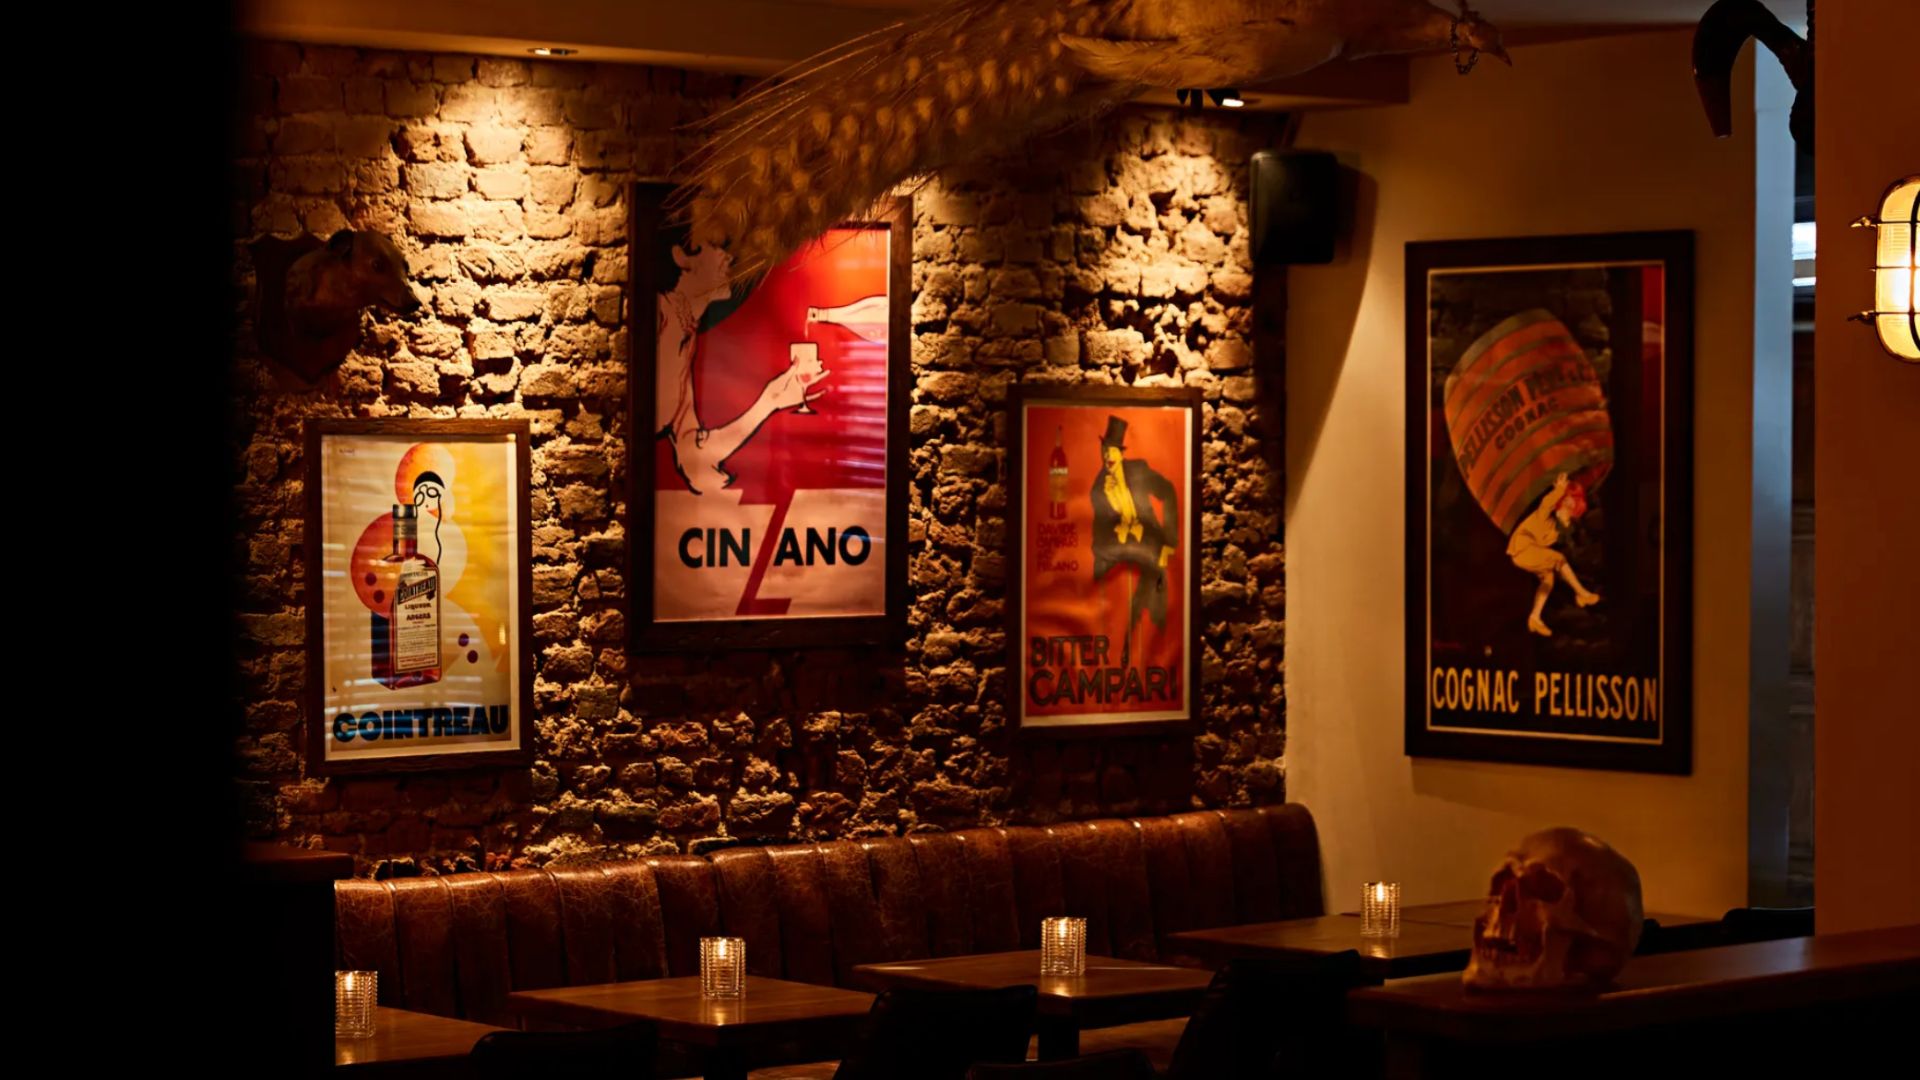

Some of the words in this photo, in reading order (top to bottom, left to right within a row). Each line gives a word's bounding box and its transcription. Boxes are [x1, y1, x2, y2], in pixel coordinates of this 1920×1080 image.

[1031, 635, 1109, 667] BITTER
[1029, 666, 1177, 706] CAMPARI
[1432, 667, 1519, 714] COGNAC
[1535, 672, 1657, 722] PELLISSON
[333, 704, 508, 743] COINTREAU
